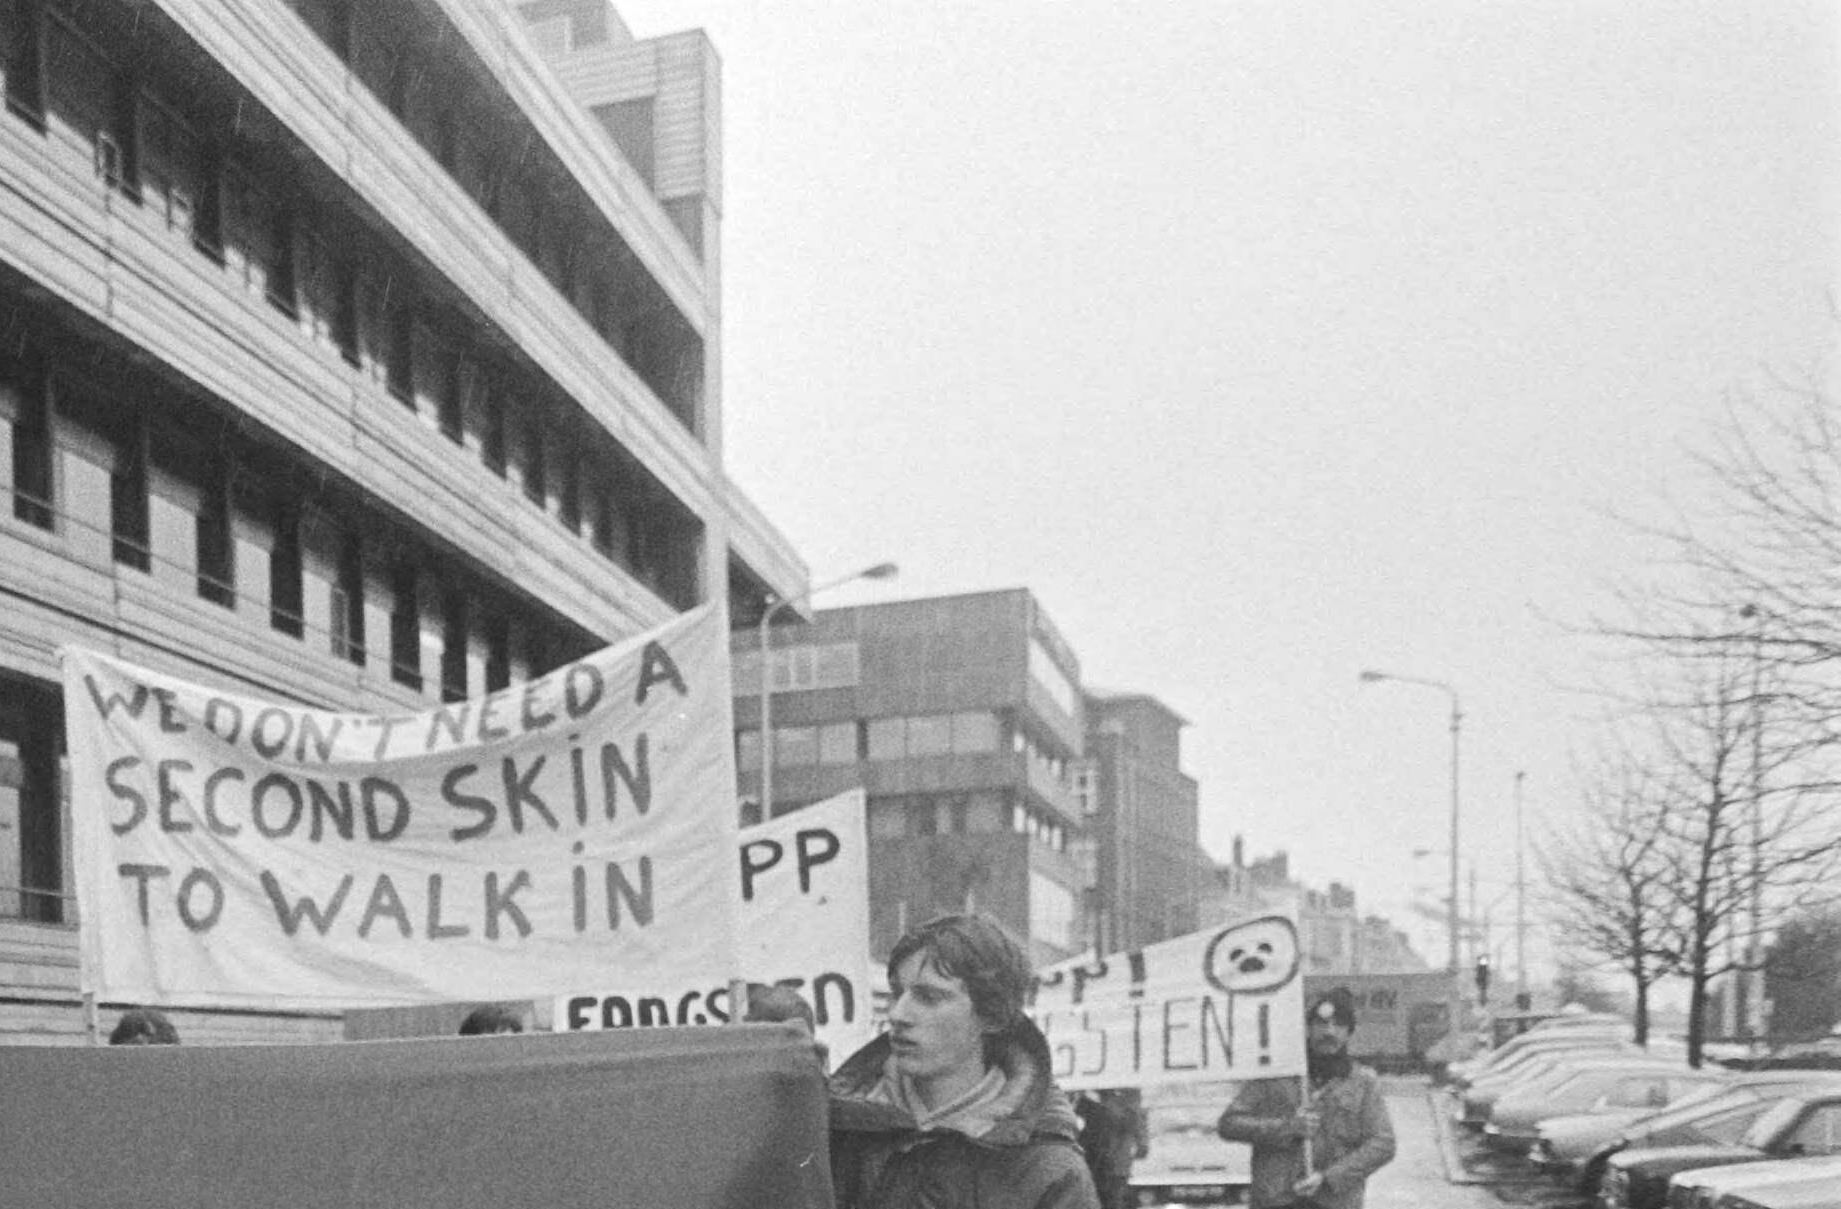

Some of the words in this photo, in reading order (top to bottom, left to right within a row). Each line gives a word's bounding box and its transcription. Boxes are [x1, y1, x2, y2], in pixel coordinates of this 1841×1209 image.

[83, 673, 187, 733] WE
[204, 697, 419, 763] DON'T
[424, 663, 605, 750] NEED
[635, 640, 689, 705] A
[105, 755, 411, 842] SECOND
[118, 863, 226, 934] TO
[260, 869, 533, 940] WALK
